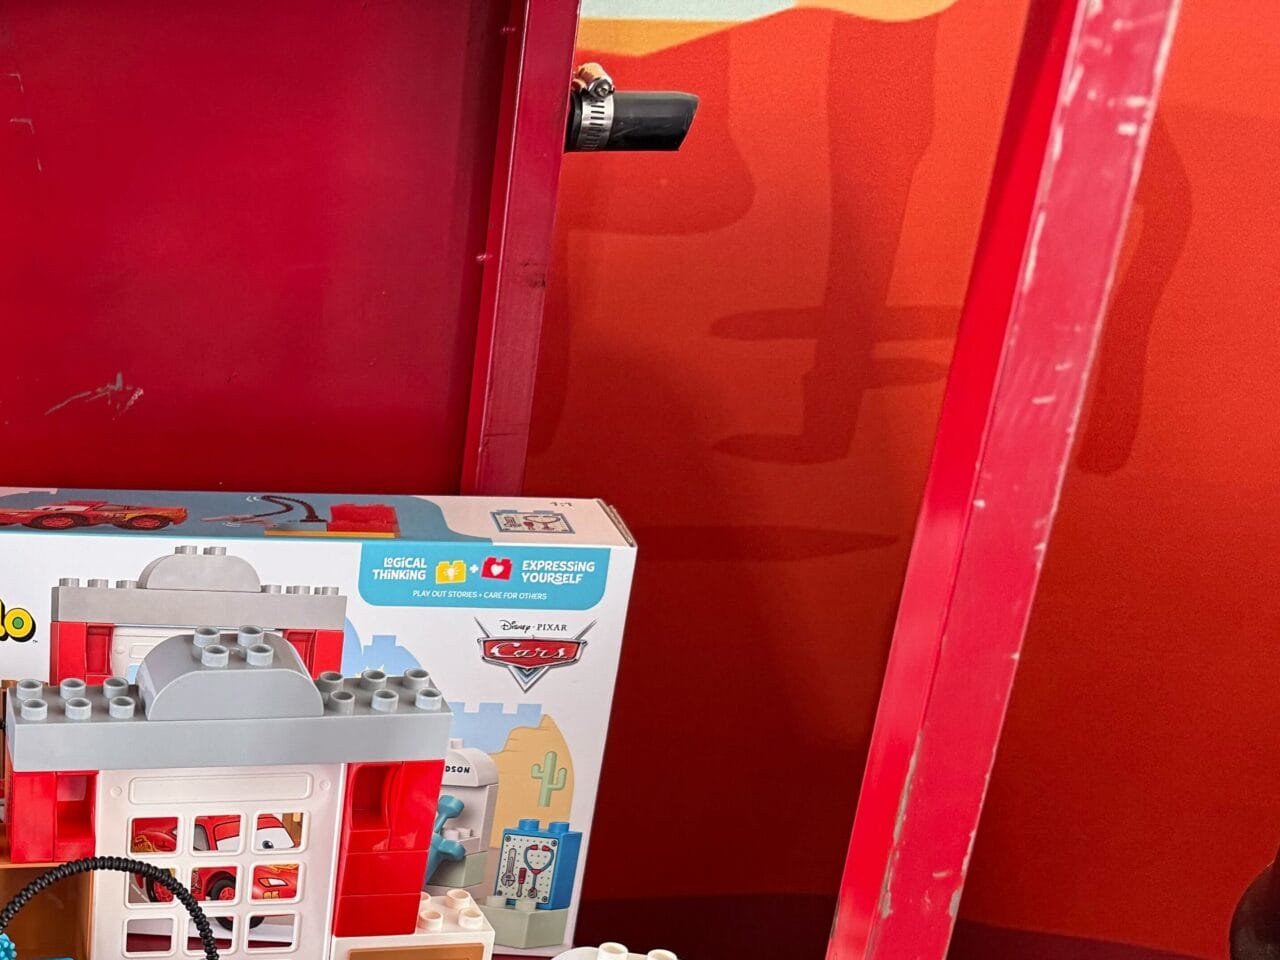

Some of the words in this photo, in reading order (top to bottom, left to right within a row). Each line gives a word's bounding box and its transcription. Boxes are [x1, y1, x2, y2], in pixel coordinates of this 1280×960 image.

[383, 557, 427, 569] LOGICAL
[522, 560, 595, 573] EXPRESSING
[372, 569, 427, 581] THINKING
[521, 572, 584, 585] YOURSELF
[412, 590, 429, 598] PLAY
[430, 590, 447, 598] OUT
[447, 590, 477, 599] STORIES
[483, 591, 502, 599] CARE
[503, 592, 518, 600] FOR
[518, 592, 548, 600] OTHERS
[499, 619, 531, 633] Disney
[536, 623, 568, 632] PIXAR
[489, 641, 572, 659] Cars
[445, 765, 471, 774] DSON
